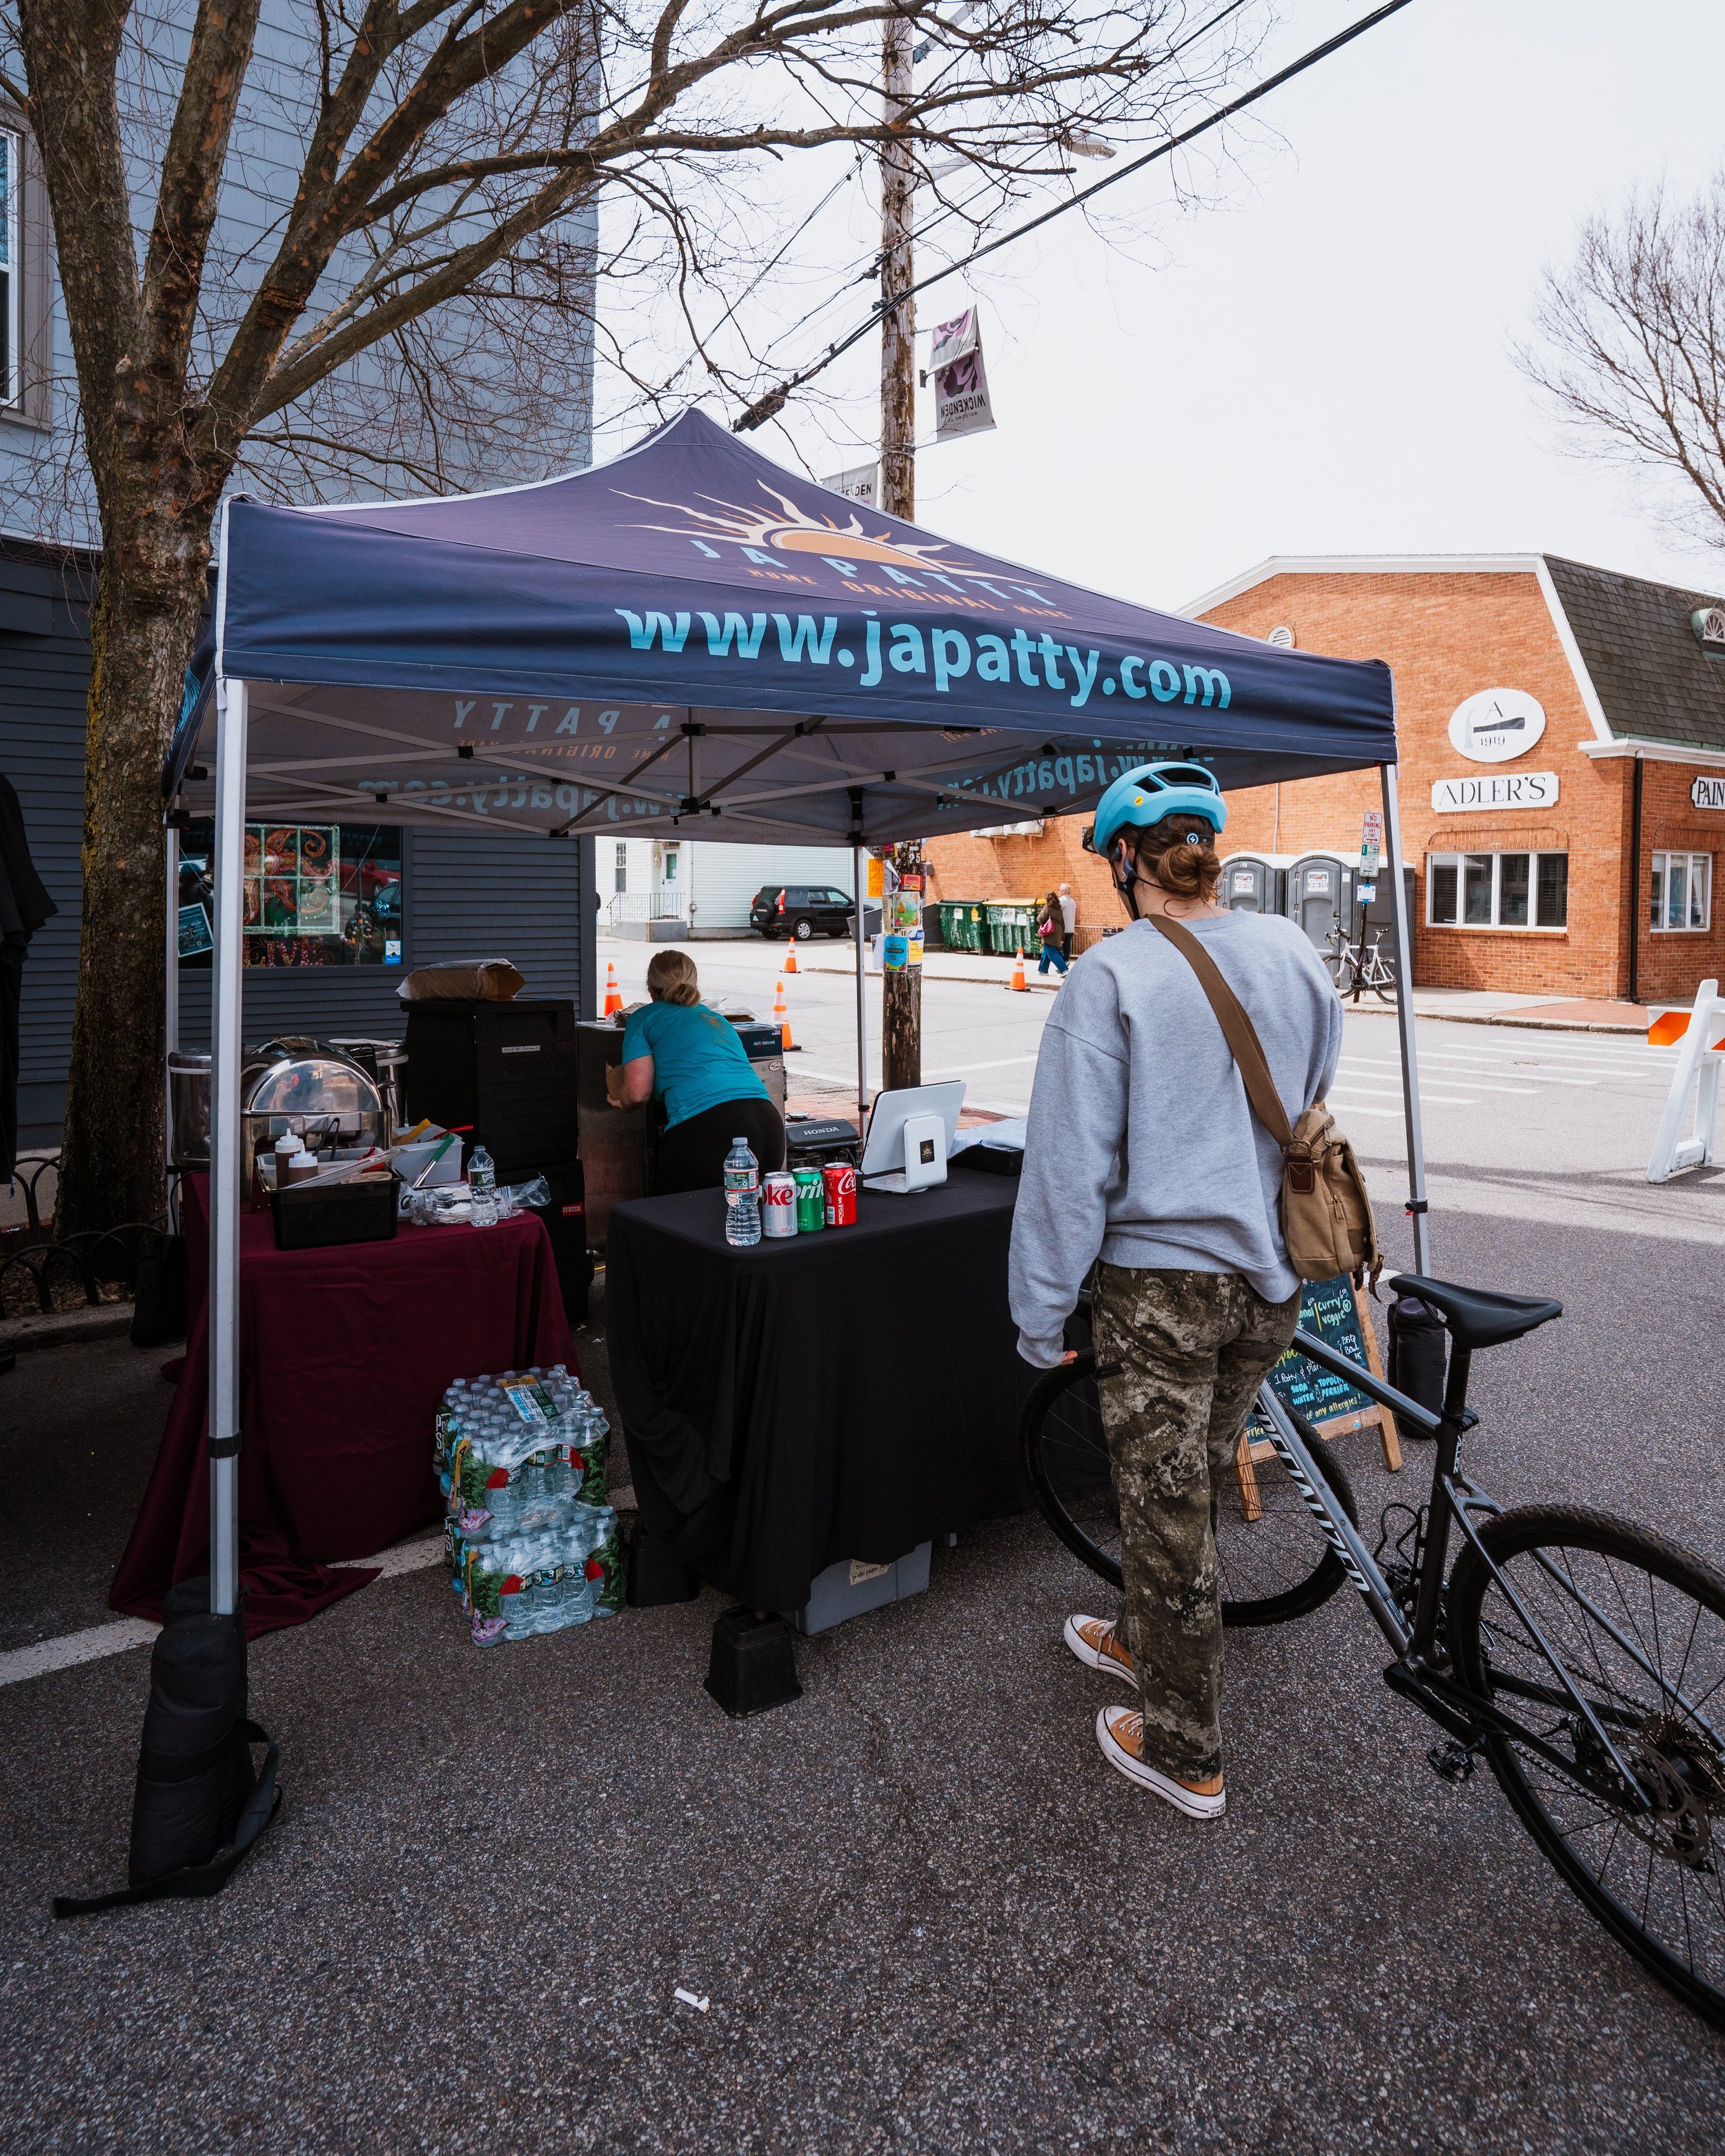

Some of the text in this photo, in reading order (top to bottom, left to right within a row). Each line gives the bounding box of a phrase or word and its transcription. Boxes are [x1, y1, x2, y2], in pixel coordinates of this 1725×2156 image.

[940, 394, 986, 418] WICKENDEN
[689, 540, 1057, 606] JA PATTY
[746, 569, 1073, 619] HOME ORIGINAL MADE
[614, 609, 1232, 710] www.japatty.com
[1485, 701, 1504, 720] A
[1480, 735, 1506, 746] 1919
[1438, 776, 1546, 805] ADLER'S
[803, 1127, 839, 1136] HONDA
[1341, 1334, 1357, 1345] BBQ
[1281, 1373, 1297, 1384] Patty
[1290, 1383, 1308, 1393] SODA
[1292, 1392, 1315, 1405] WATER
[1321, 1383, 1350, 1398] PERRIER
[1315, 1407, 1327, 1418] any
[1453, 1435, 1462, 1474] ALLEZ
